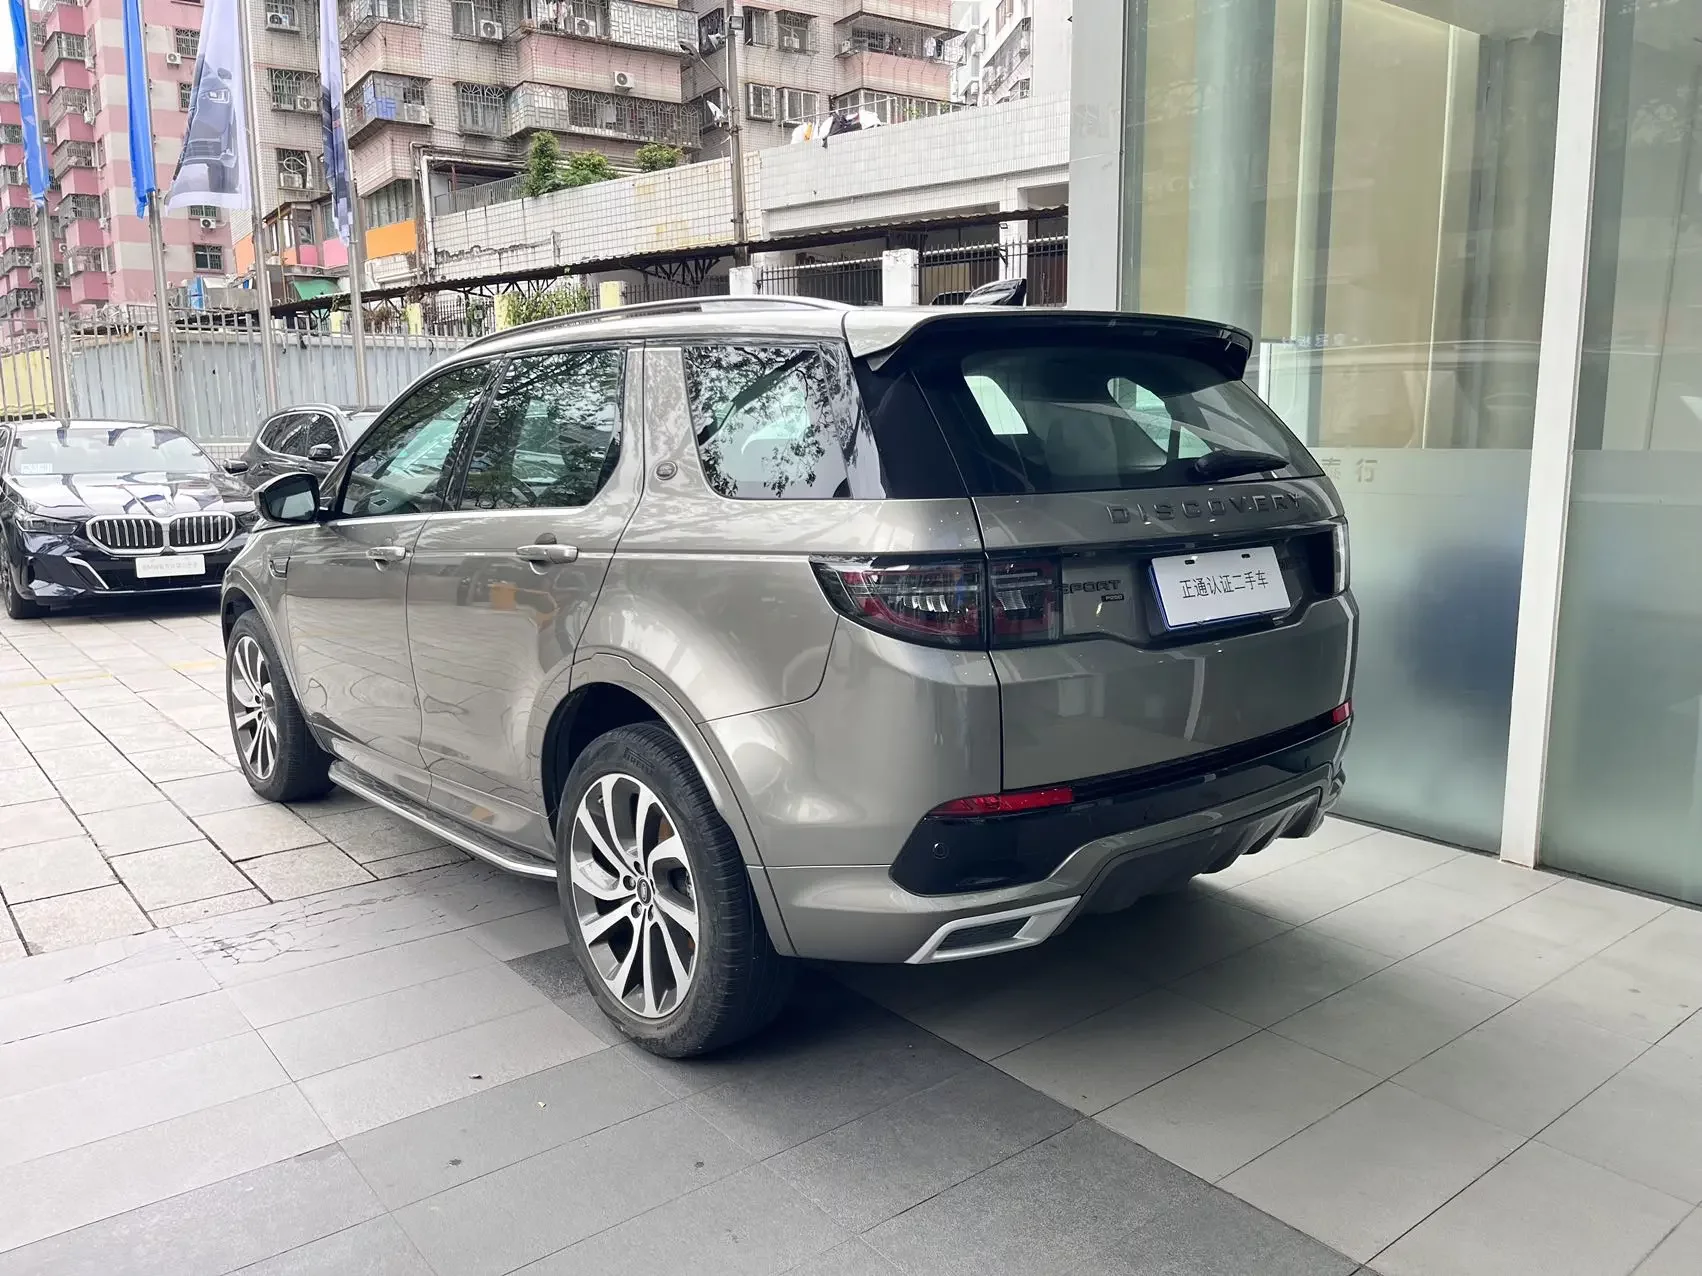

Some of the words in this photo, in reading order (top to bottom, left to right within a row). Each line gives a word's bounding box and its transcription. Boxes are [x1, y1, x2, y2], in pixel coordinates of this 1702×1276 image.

[1106, 493, 1300, 524] DISCOVERY
[1058, 580, 1121, 595] SPORT
[1179, 570, 1269, 598] 正通认证二手车
